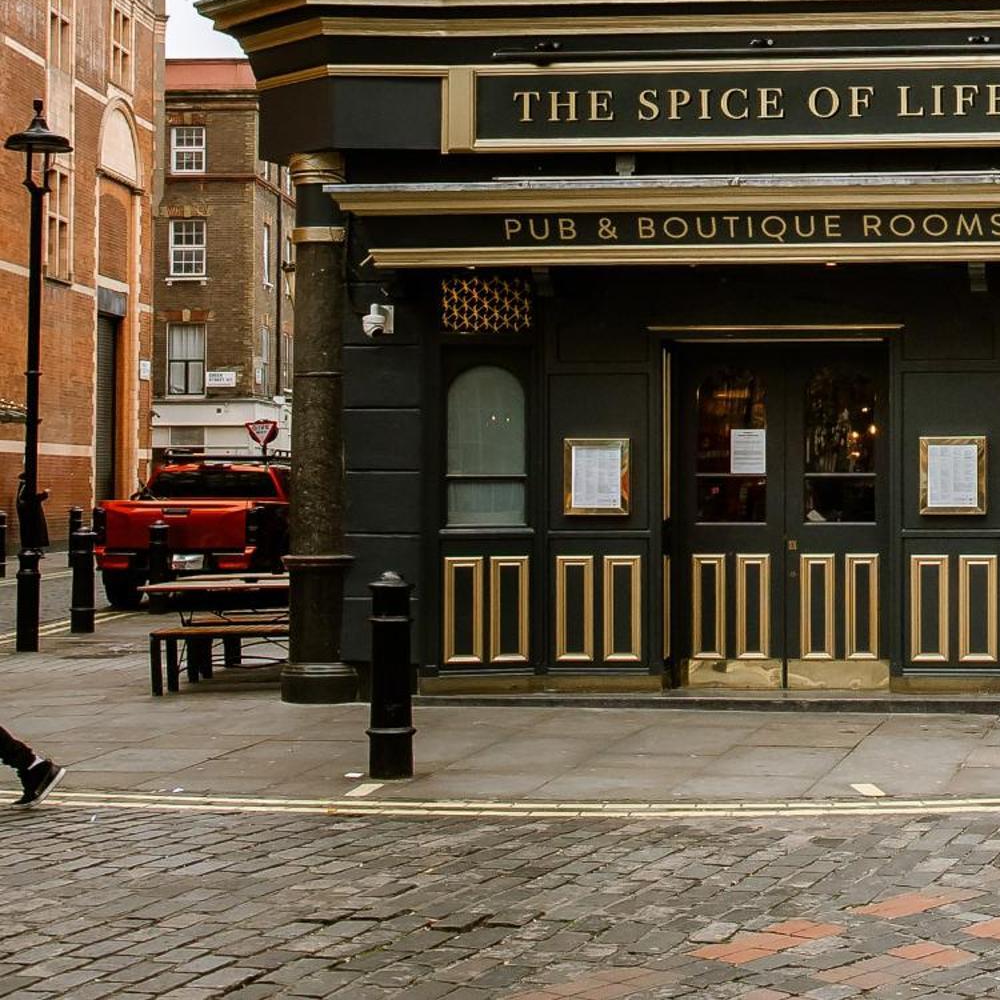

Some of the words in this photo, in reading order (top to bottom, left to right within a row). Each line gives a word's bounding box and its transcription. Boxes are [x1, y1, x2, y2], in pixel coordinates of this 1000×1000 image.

[513, 89, 615, 123] THE
[637, 86, 786, 122] SPICE
[807, 85, 876, 120] OF
[503, 217, 577, 242] PUB
[597, 217, 619, 240] &
[639, 214, 842, 242] BOUTIQUE
